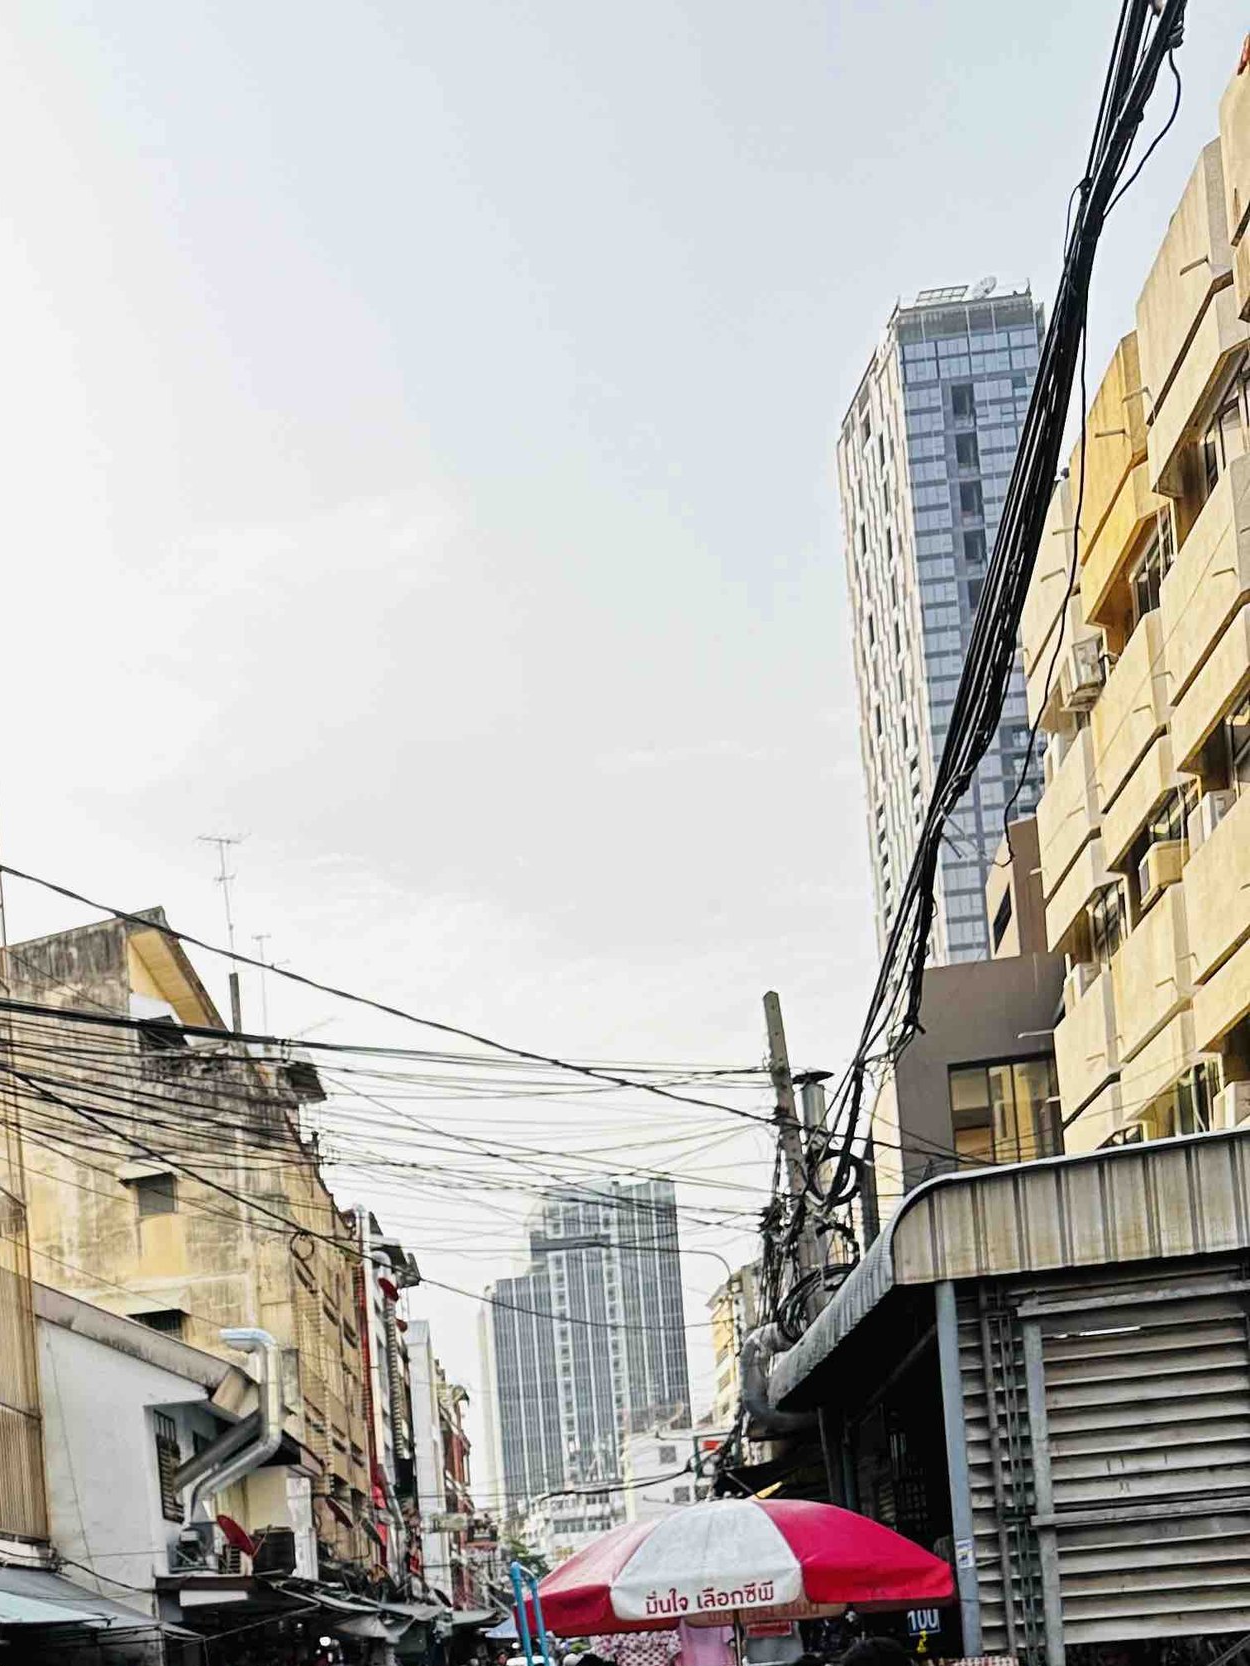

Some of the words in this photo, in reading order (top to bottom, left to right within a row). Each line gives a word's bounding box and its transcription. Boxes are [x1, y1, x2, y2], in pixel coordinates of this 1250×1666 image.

[645, 1588, 689, 1616] มั่นใจ
[697, 1581, 775, 1609] เลือกซีพี
